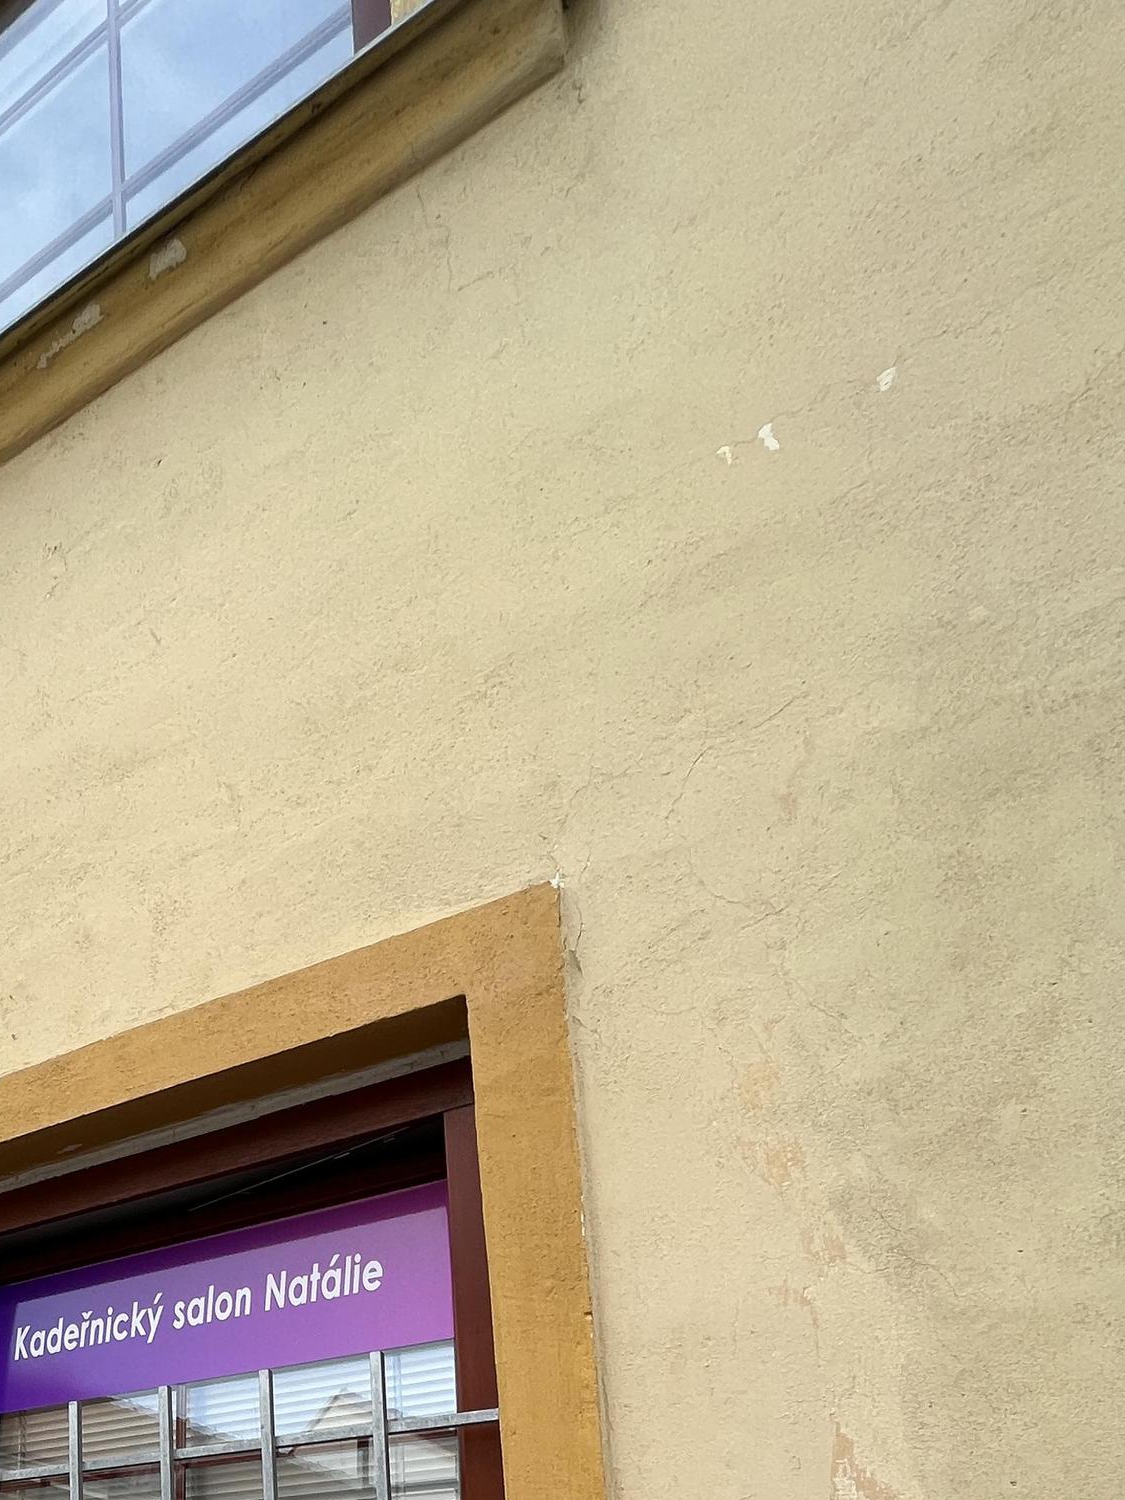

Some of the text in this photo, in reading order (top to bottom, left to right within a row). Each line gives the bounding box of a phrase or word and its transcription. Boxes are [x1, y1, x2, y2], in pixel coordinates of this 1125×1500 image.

[13, 1252, 384, 1361] Kadeřnický salon Natálie
